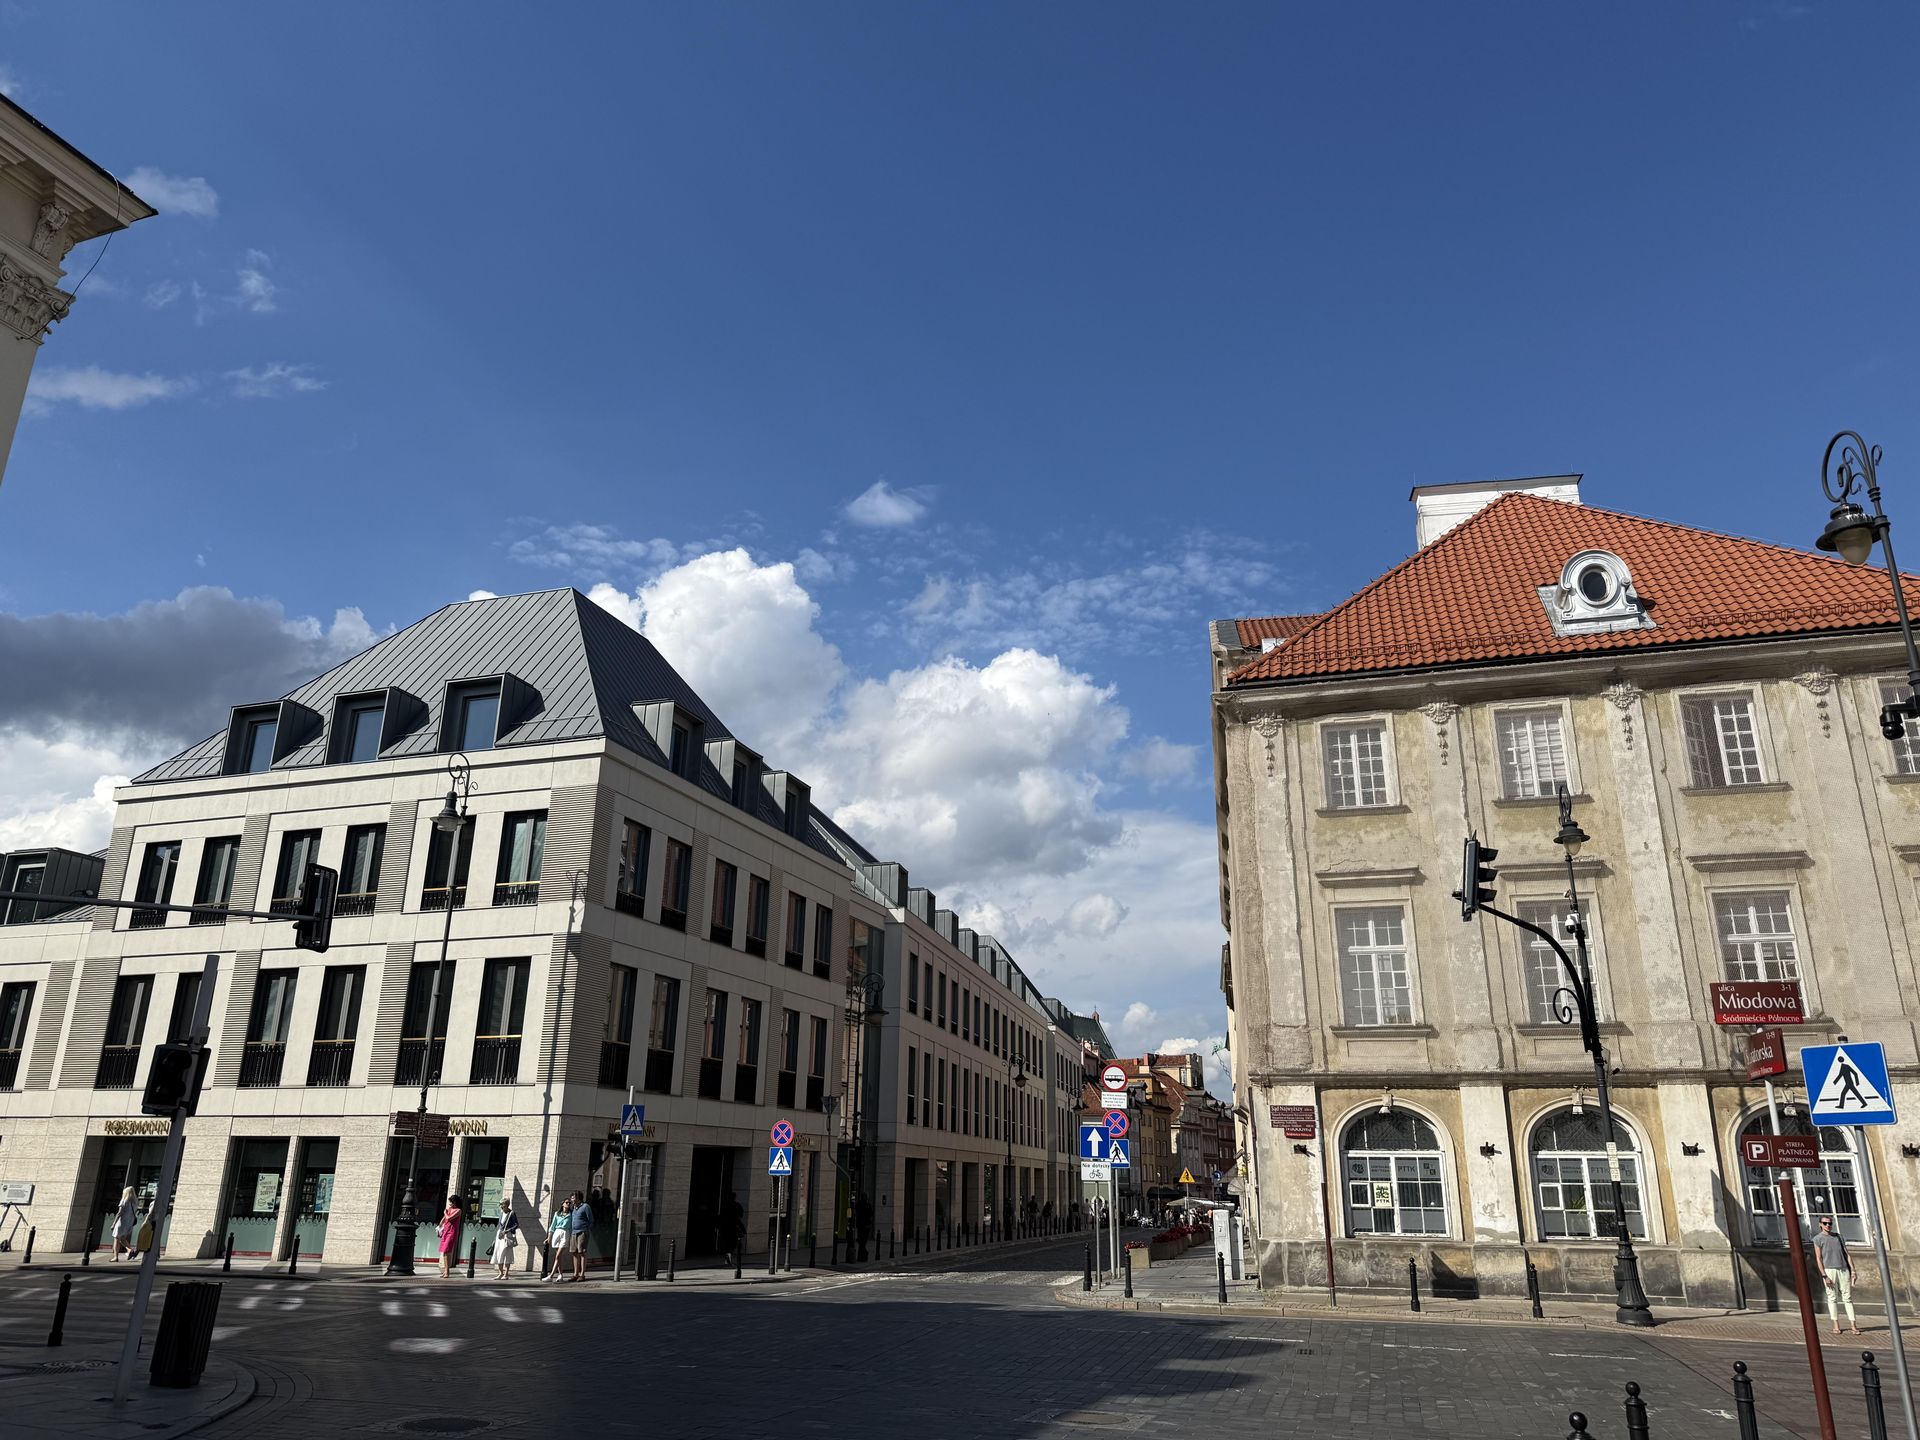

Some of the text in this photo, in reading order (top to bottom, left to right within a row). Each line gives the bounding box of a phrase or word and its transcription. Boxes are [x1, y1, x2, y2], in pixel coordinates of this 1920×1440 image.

[1718, 984, 1735, 992] ulica
[1720, 992, 1797, 1009] Miodowa
[1722, 1014, 1766, 1023] Śródmieście
[1751, 1144, 1814, 1158] P PŁATNEGO
